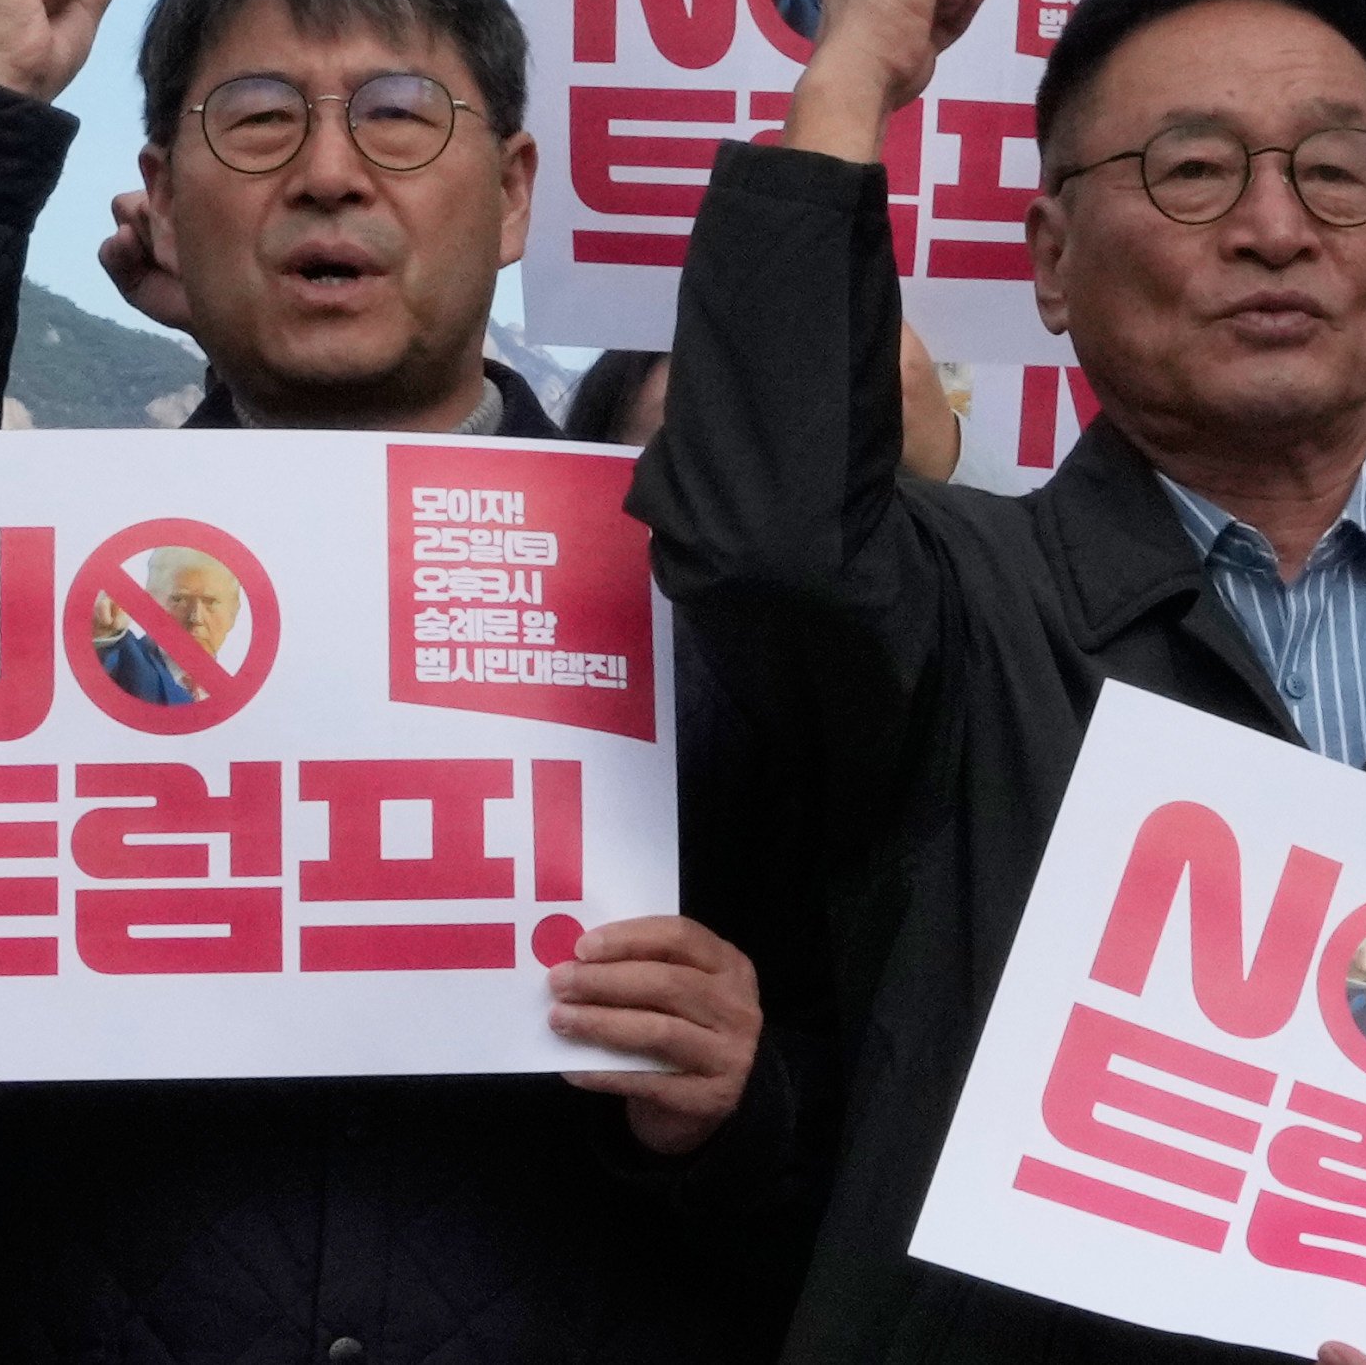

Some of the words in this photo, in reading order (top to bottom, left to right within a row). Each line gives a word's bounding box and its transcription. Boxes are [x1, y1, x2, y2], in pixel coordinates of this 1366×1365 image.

[413, 487, 525, 524] 모이자!
[414, 526, 558, 565] 25일(토)
[415, 608, 519, 643] 숭례문
[523, 611, 558, 644] 앞
[416, 647, 628, 689] 범시민대행진!
